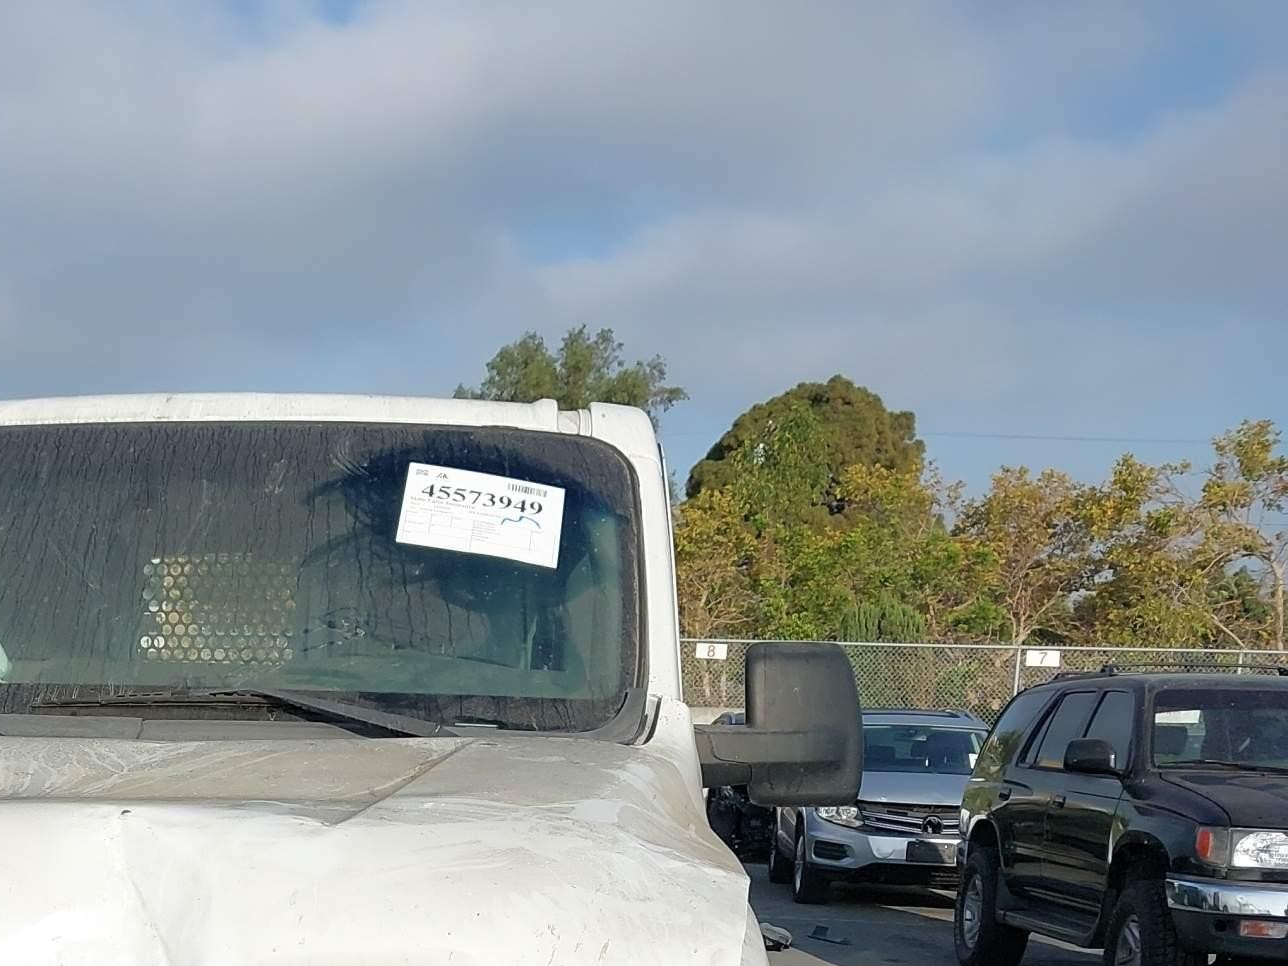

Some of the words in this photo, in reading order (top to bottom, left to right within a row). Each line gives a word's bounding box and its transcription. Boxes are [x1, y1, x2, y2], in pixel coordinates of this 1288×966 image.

[420, 483, 543, 514] 45573949
[707, 645, 716, 658] 8
[1038, 651, 1048, 665] 7
